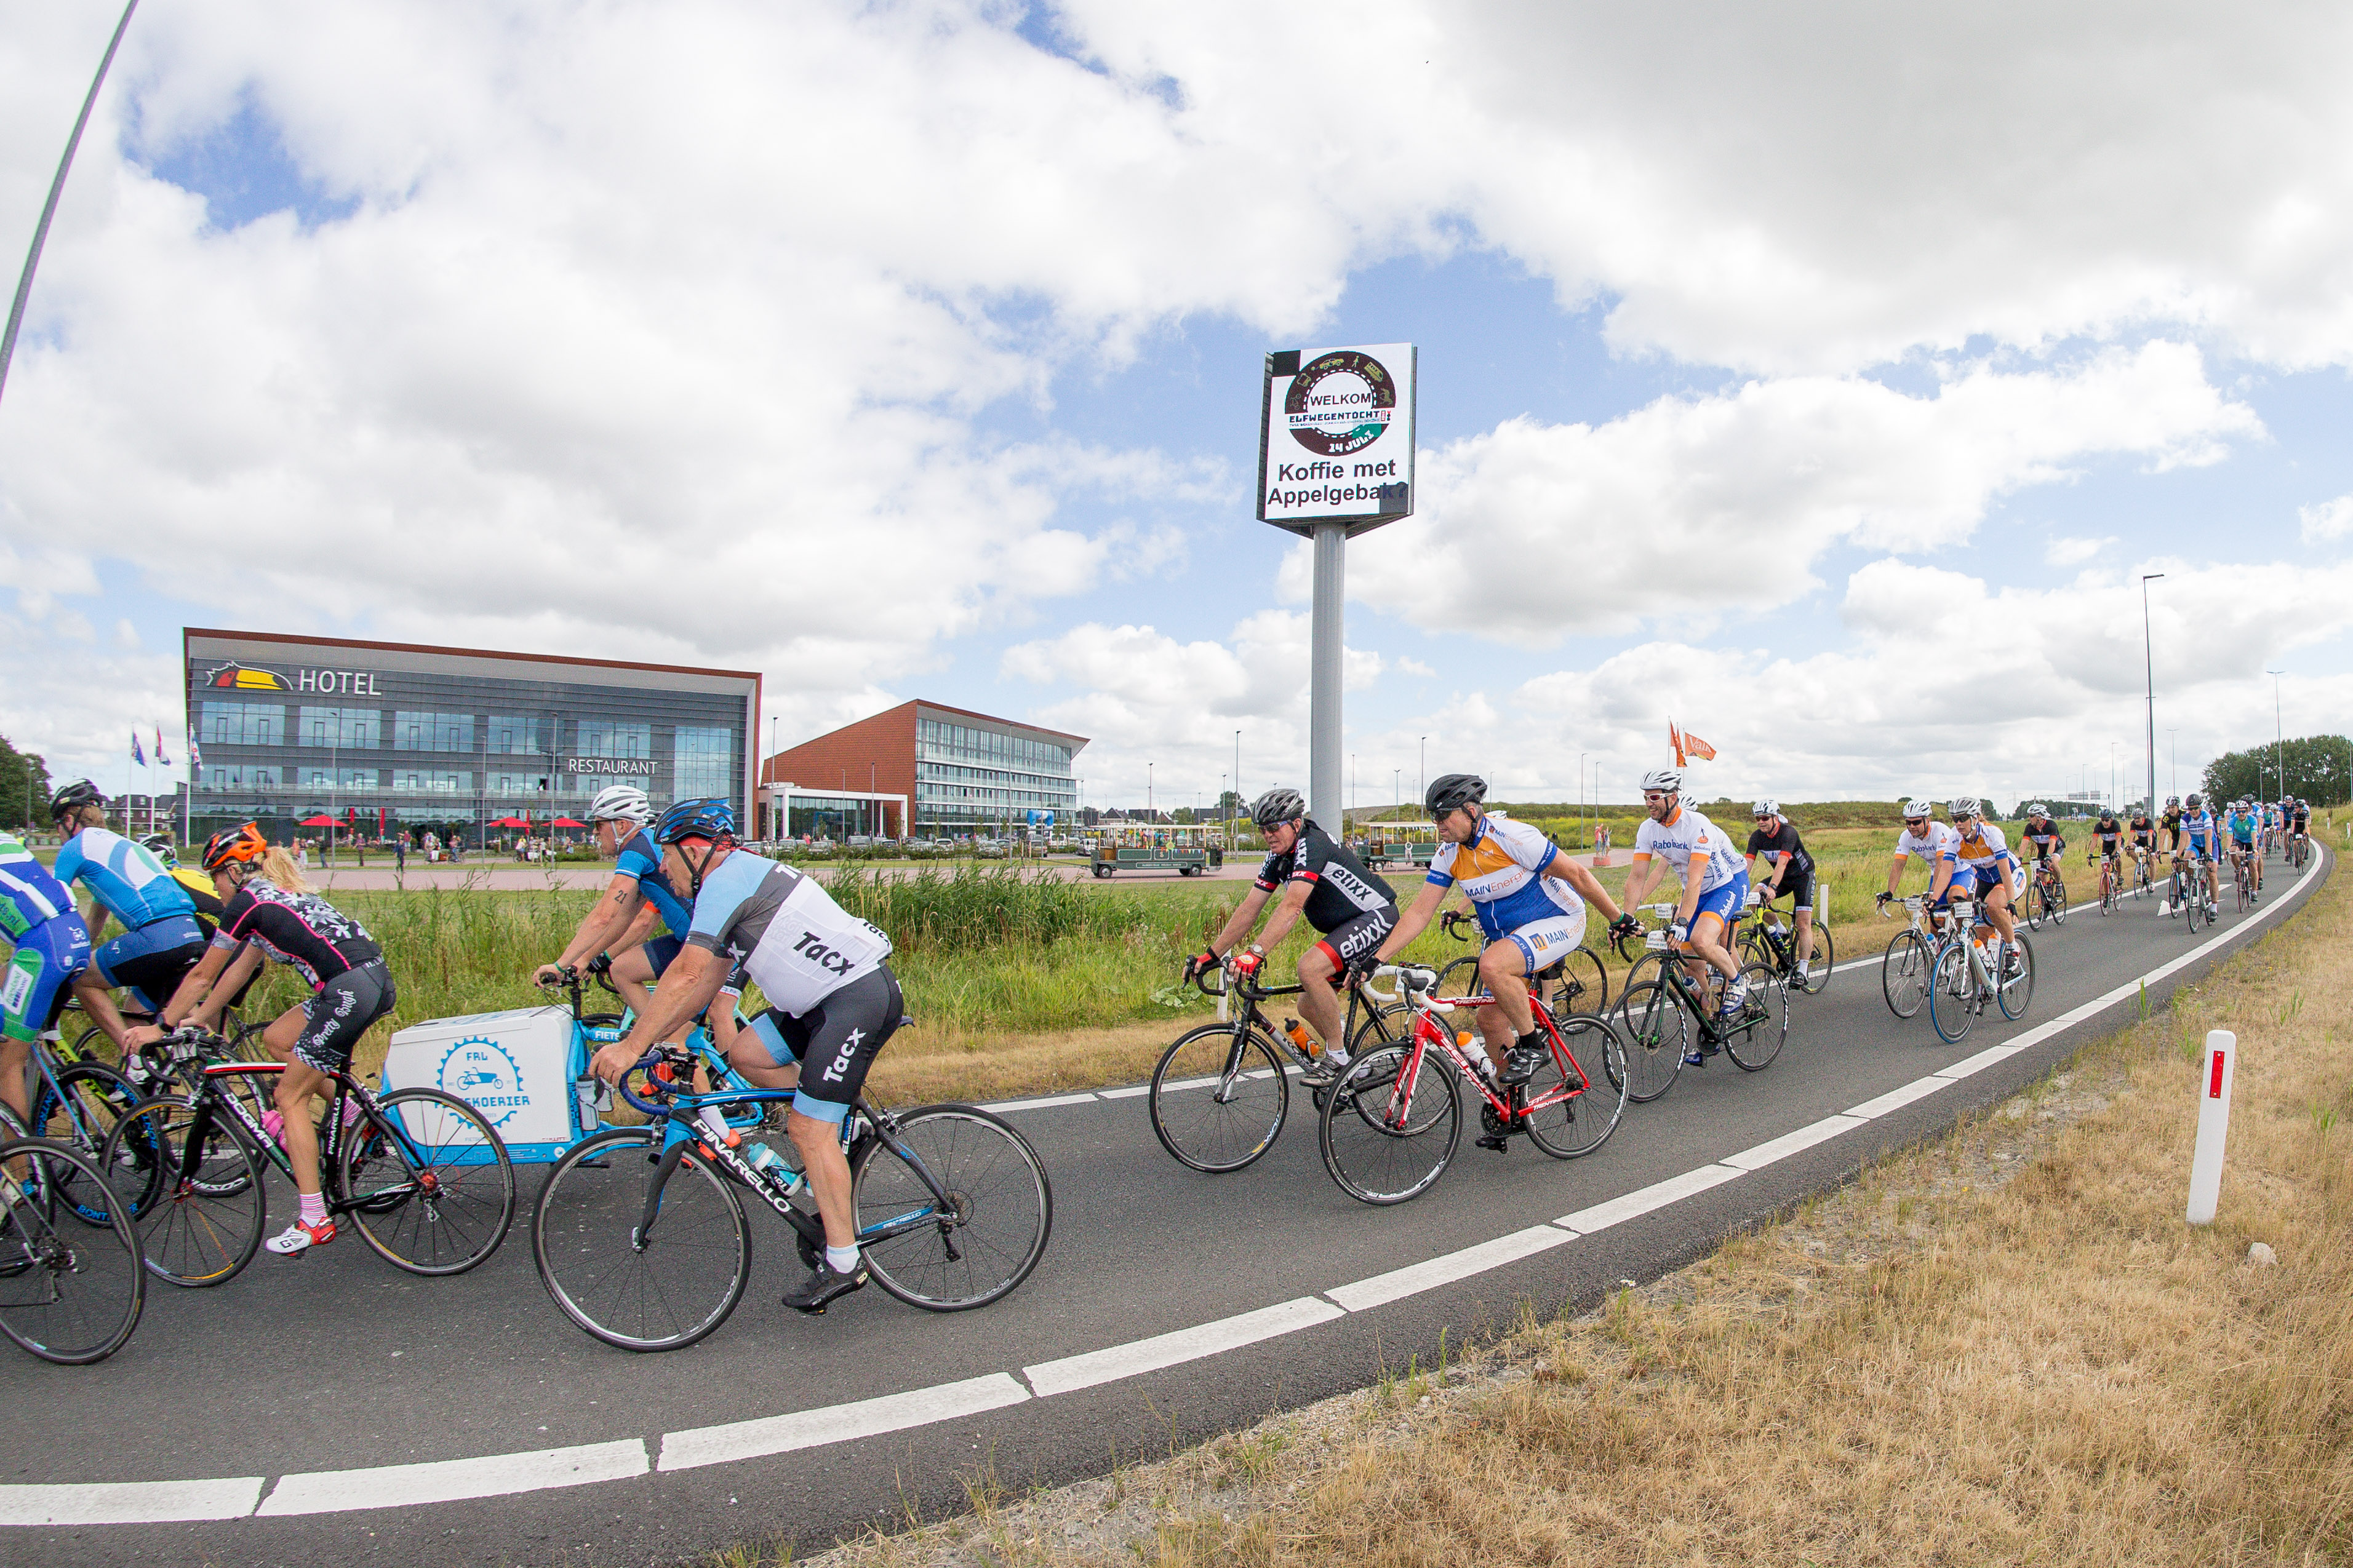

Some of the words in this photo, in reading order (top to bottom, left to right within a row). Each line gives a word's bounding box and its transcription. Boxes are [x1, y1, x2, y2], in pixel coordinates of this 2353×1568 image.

[1310, 393, 1371, 406] WELKOM
[1289, 411, 1380, 423] ELFWEGENTOCHT
[1328, 444, 1343, 453] 14
[1345, 429, 1374, 452] JULI
[1279, 461, 1344, 481] Koffie
[1354, 459, 1396, 477] met
[299, 669, 382, 696] HOTEL
[569, 758, 658, 774] RESTAURANT
[1653, 839, 1689, 851] Rabobank
[1331, 866, 1372, 901] etixx
[614, 889, 628, 904] 21
[1719, 890, 1736, 919] Rabobank
[1340, 918, 1388, 959] etixx
[793, 931, 855, 976] Tacx
[466, 1052, 488, 1061] FRL
[823, 1027, 866, 1082] Tacx
[224, 1092, 274, 1148] DOGMA
[327, 1097, 341, 1155] PINARELLO
[692, 1118, 790, 1212] PINARELLO
[374, 1187, 412, 1196] PINARELLO
